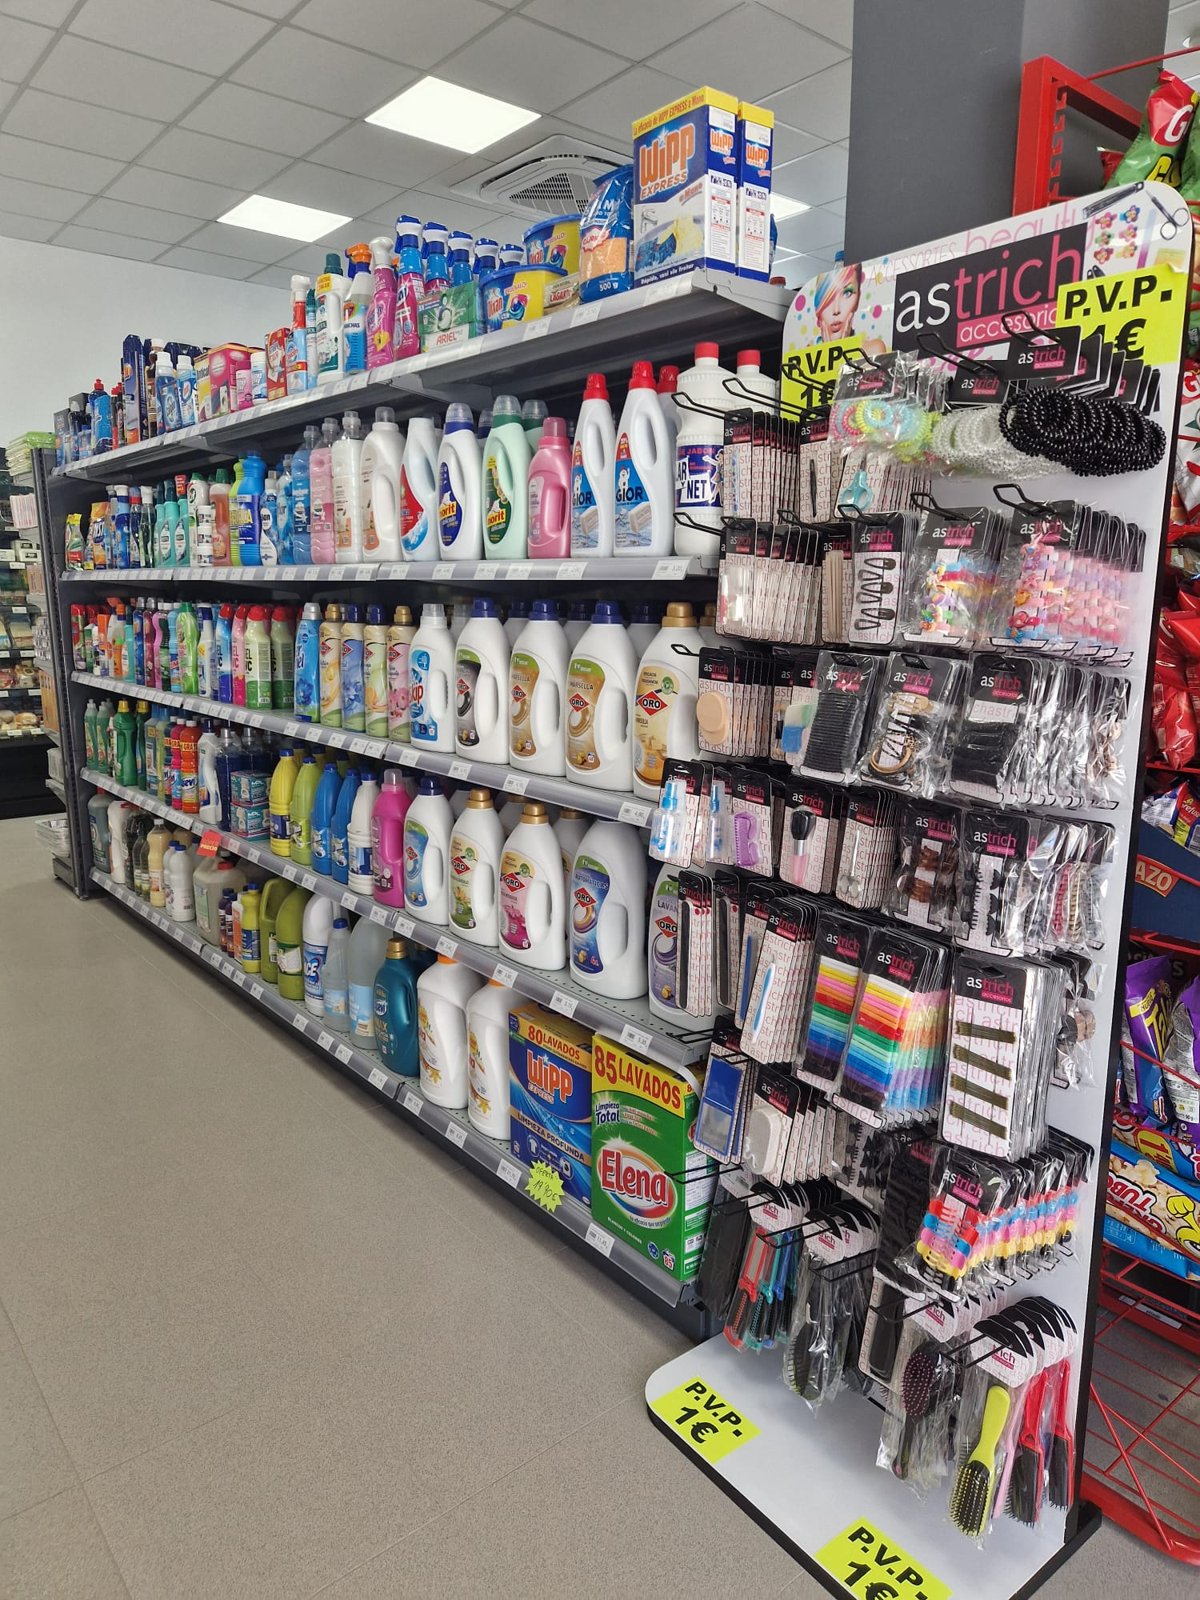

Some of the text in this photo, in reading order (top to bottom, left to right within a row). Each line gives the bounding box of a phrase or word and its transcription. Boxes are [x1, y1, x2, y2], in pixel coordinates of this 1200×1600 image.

[641, 170, 688, 200] EXPRESS
[895, 234, 1081, 333] astrich
[1064, 274, 1173, 321] P.V.P.
[436, 332, 457, 346] ARIEL
[1017, 346, 1068, 364] astrich
[961, 376, 1000, 390] astrich
[724, 424, 752, 437] astrich
[686, 479, 707, 500] NET
[439, 504, 455, 517] norit
[487, 510, 504, 525] norit
[859, 529, 894, 544] astrich
[932, 521, 976, 539] astrich
[703, 663, 729, 673] astrich
[893, 670, 934, 686] astrich
[980, 674, 1022, 691] astrich
[571, 698, 584, 708] ORO
[642, 699, 661, 709] ORO
[737, 783, 765, 798] astrich
[792, 792, 824, 808] astrich
[915, 815, 955, 832] astrich
[973, 830, 1017, 848] astrich
[576, 892, 591, 903] ORO
[659, 920, 678, 933] ORO
[769, 914, 798, 933] astrich
[826, 932, 861, 950] astrich
[877, 952, 915, 974] astrich
[966, 976, 1014, 996] astrich
[528, 1024, 543, 1045] 80
[543, 1033, 580, 1060] LAVADOS
[594, 1044, 617, 1085] 85
[619, 1058, 681, 1110] LAVADOS
[528, 1082, 555, 1105] EXPRESS
[761, 1081, 790, 1106] astrich
[595, 1101, 620, 1112] Limpieza
[595, 1110, 620, 1125] Total
[517, 1112, 545, 1138] LIMPIEZA
[546, 1132, 585, 1162] PROFUNDA
[535, 1166, 554, 1180] OFERTA
[601, 1148, 669, 1206] Elena
[943, 1169, 984, 1198] astrich
[664, 1256, 673, 1268] 85
[684, 1381, 743, 1438] P.V.P.
[674, 1406, 719, 1444] 1€
